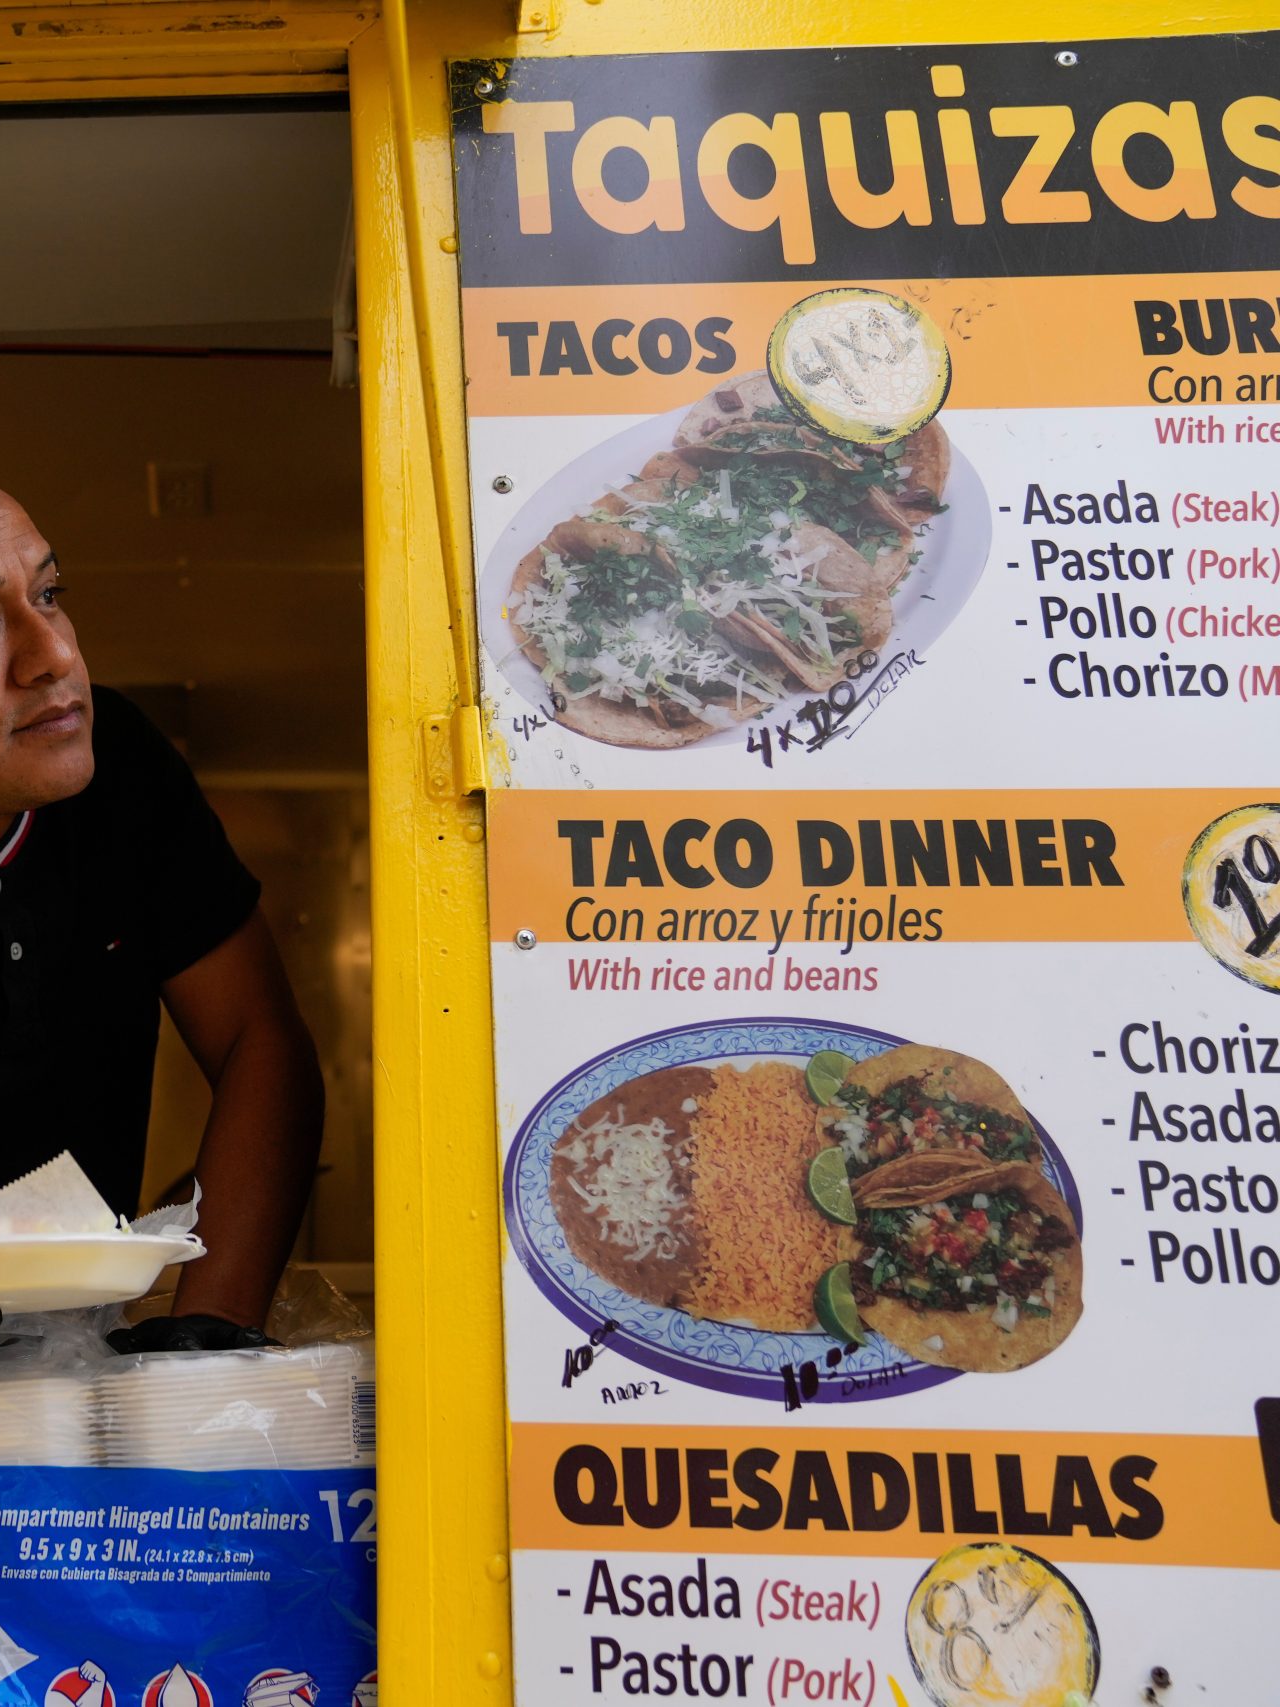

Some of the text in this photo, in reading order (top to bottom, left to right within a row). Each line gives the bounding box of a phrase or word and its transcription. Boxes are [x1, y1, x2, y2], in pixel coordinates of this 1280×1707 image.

[482, 64, 1280, 265] Taquizas
[497, 317, 736, 376] TACOS
[1134, 298, 1280, 356] BUR
[1148, 366, 1222, 404] Con
[1155, 415, 1280, 444] With rice
[1022, 480, 1280, 528] Asada (Steak)
[1031, 539, 1280, 585] Pastor (Pork)
[1039, 592, 1280, 643] Pollo (Chicke
[1048, 651, 1229, 699] Chorizo
[557, 818, 1125, 889] TACO DINNER
[565, 894, 944, 956] Con arroz y frijoles
[568, 956, 879, 992] With rice and beans
[1119, 1020, 1280, 1074] Choriz
[1128, 1088, 1280, 1143] Asada
[1138, 1160, 1280, 1214] Pasto
[1148, 1228, 1280, 1286] Pollo
[553, 1444, 1165, 1541] QUESADILLAS
[108, 1505, 174, 1535] Hinged
[176, 1506, 206, 1530] Lid
[208, 1507, 311, 1532] Containers
[1, 1565, 271, 1585] Envase con Cubierta Bisagrada de 3 Compartimiento
[19, 1537, 50, 1561] 9.5
[52, 1543, 66, 1561] x
[69, 1537, 83, 1561] 9
[85, 1543, 98, 1561] x
[101, 1538, 115, 1562] 3
[117, 1538, 142, 1562] IN.
[144, 1548, 170, 1566] (24.1
[172, 1553, 180, 1563] x
[181, 1550, 205, 1563] 22.8
[206, 1553, 213, 1563] x
[232, 1548, 254, 1566] cm)
[583, 1557, 881, 1631] Asada (Steak)
[590, 1635, 876, 1707] Pastor (Pork)
